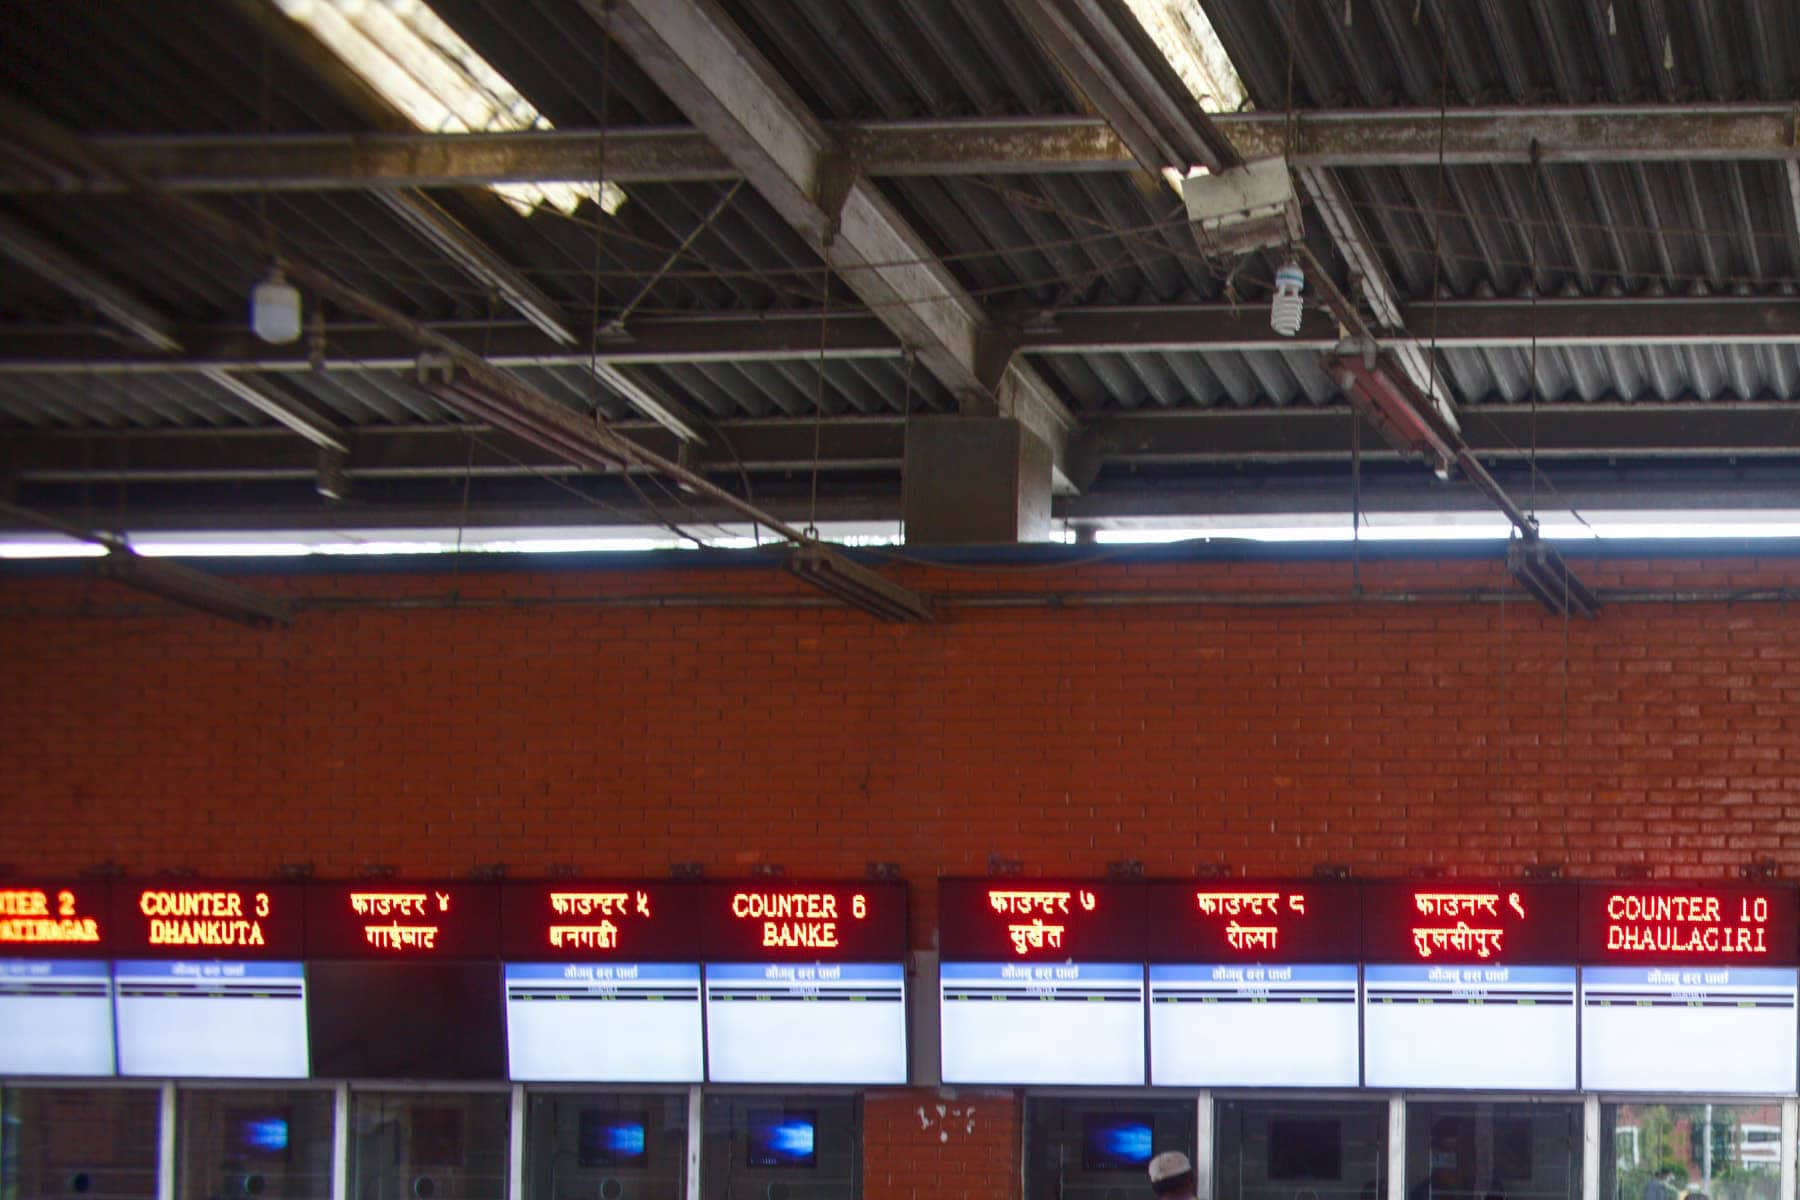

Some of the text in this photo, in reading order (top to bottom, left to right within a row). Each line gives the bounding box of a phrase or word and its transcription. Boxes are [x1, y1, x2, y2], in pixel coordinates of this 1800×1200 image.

[140, 892, 269, 917] COUNTER 3
[733, 894, 866, 918] COUNTER 6
[1080, 890, 1096, 911] ७
[1508, 892, 1525, 919] ९
[1608, 896, 1768, 922] COUNTER 10
[150, 921, 265, 945] DHANKUTA
[762, 922, 839, 948] BANKE
[1412, 921, 1503, 957] तुलसीपुर
[1607, 926, 1767, 953] DHAULAGIRI
